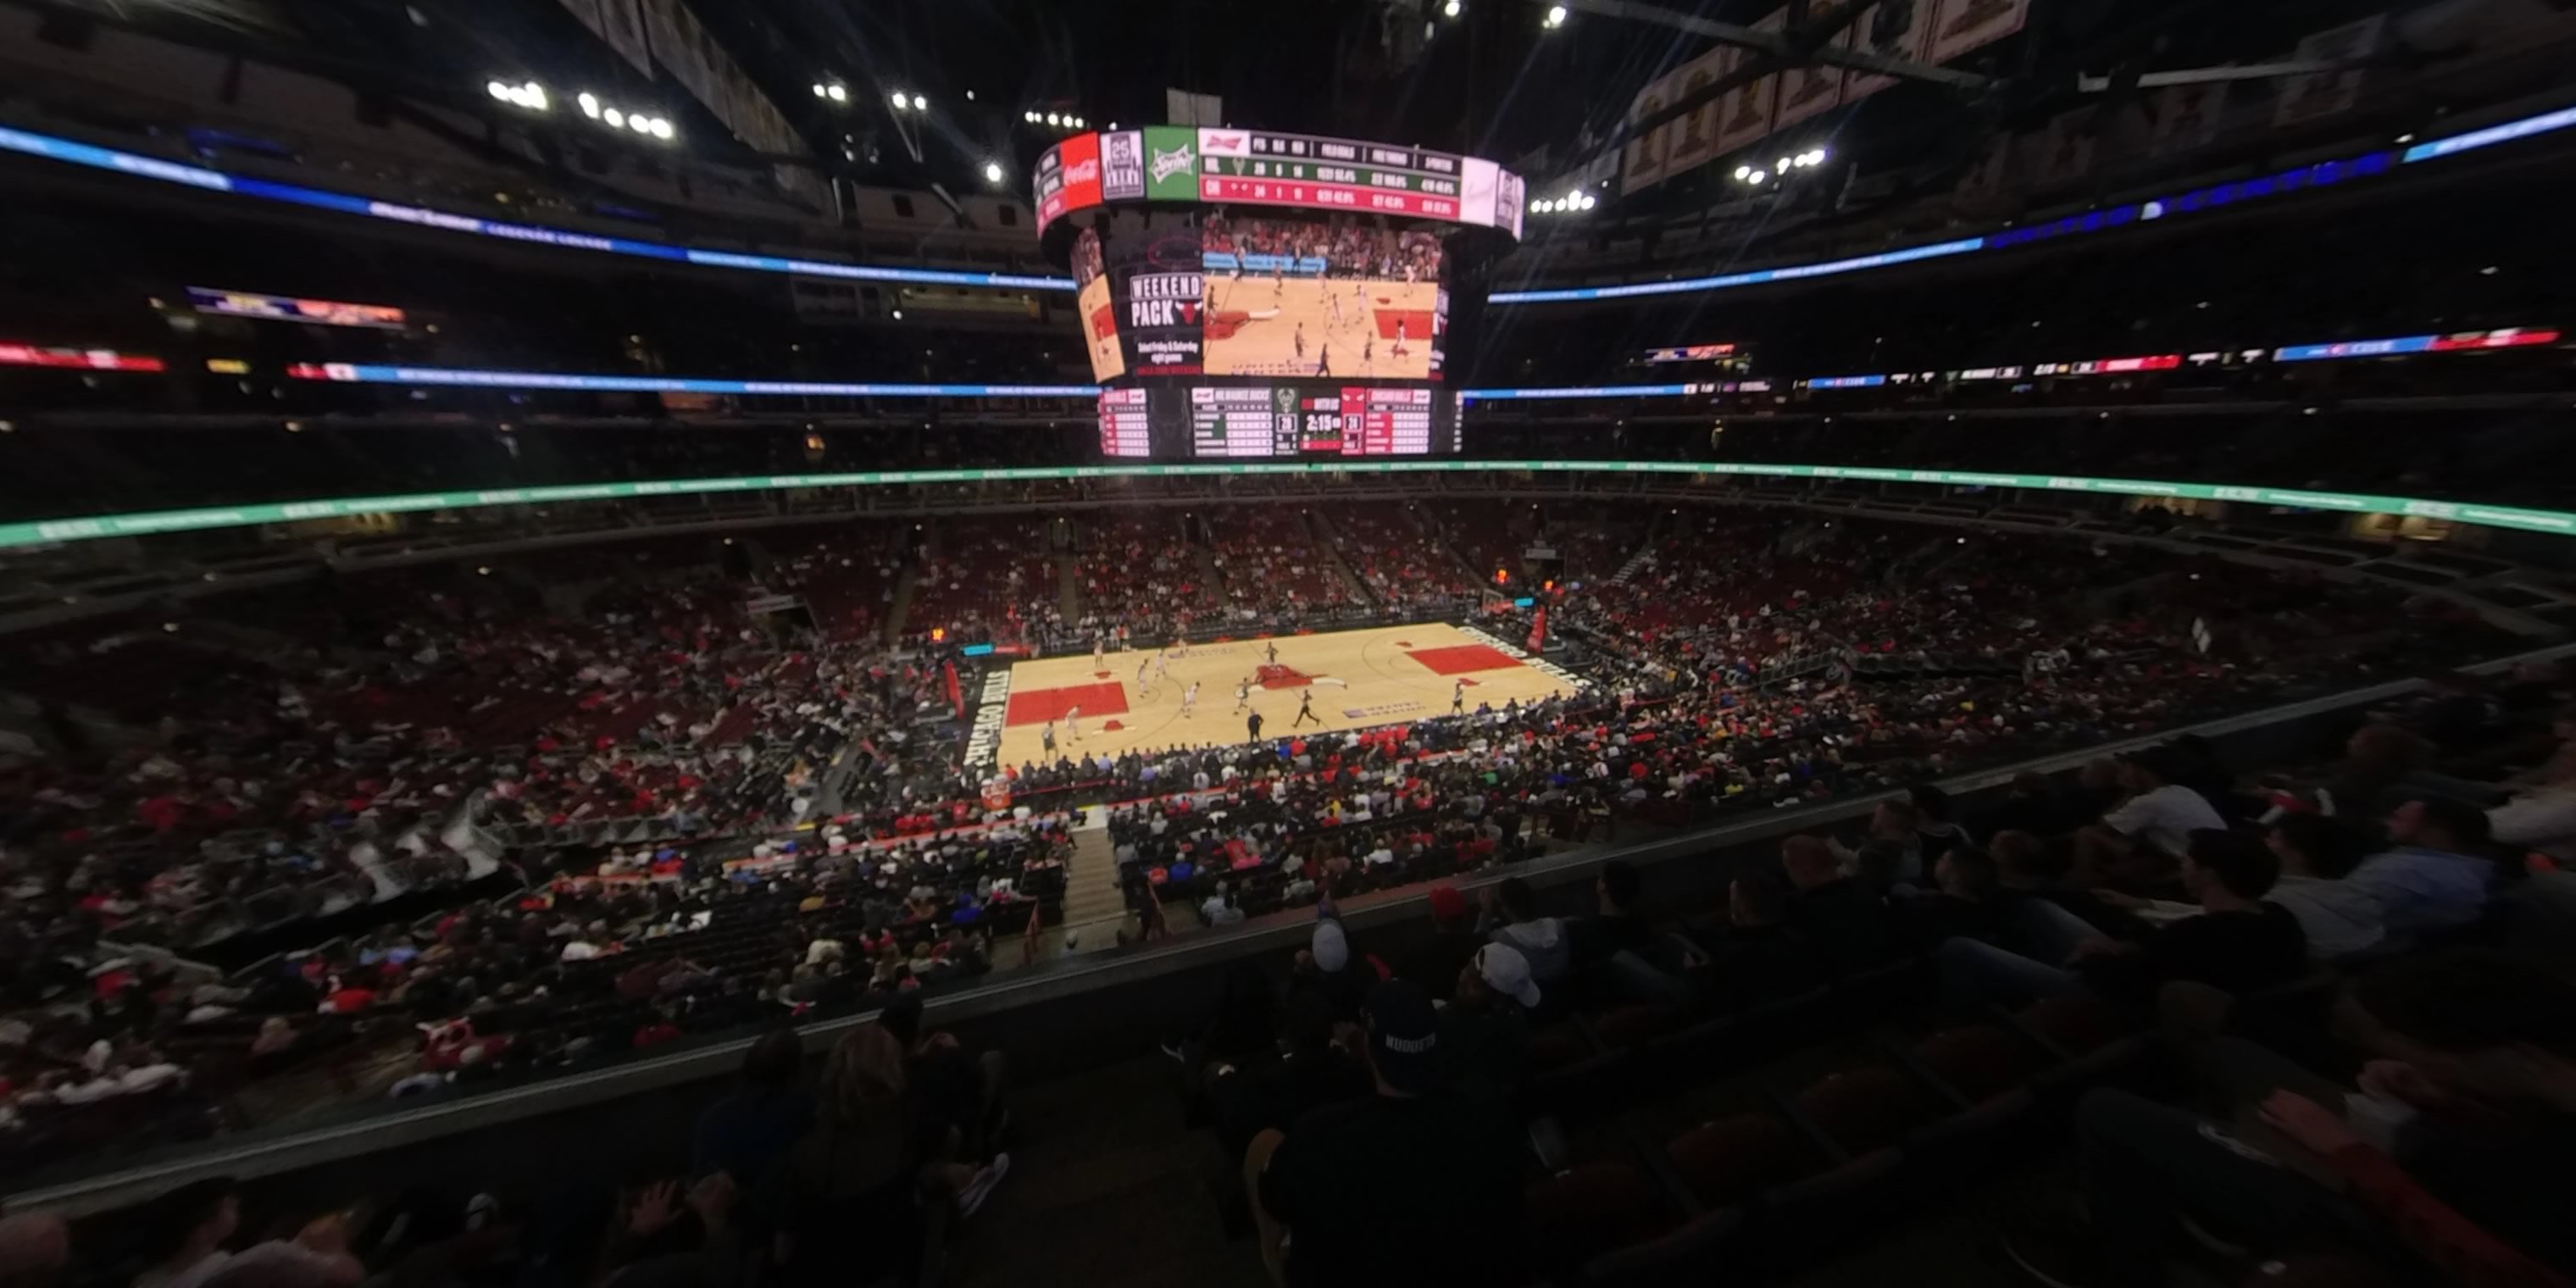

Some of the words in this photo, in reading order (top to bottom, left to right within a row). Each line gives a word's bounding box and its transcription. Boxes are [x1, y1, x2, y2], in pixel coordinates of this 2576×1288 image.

[1132, 275, 1200, 297] WEEKEND
[1131, 298, 1174, 327] PACK
[1307, 414, 1332, 430] 2:15
[1457, 625, 1529, 658] CHICAGO
[1520, 657, 1593, 691] BULLS
[980, 669, 1011, 704] BULLS
[963, 704, 1005, 767] CHICAGO
[1385, 1031, 1437, 1054] NUGGETS
